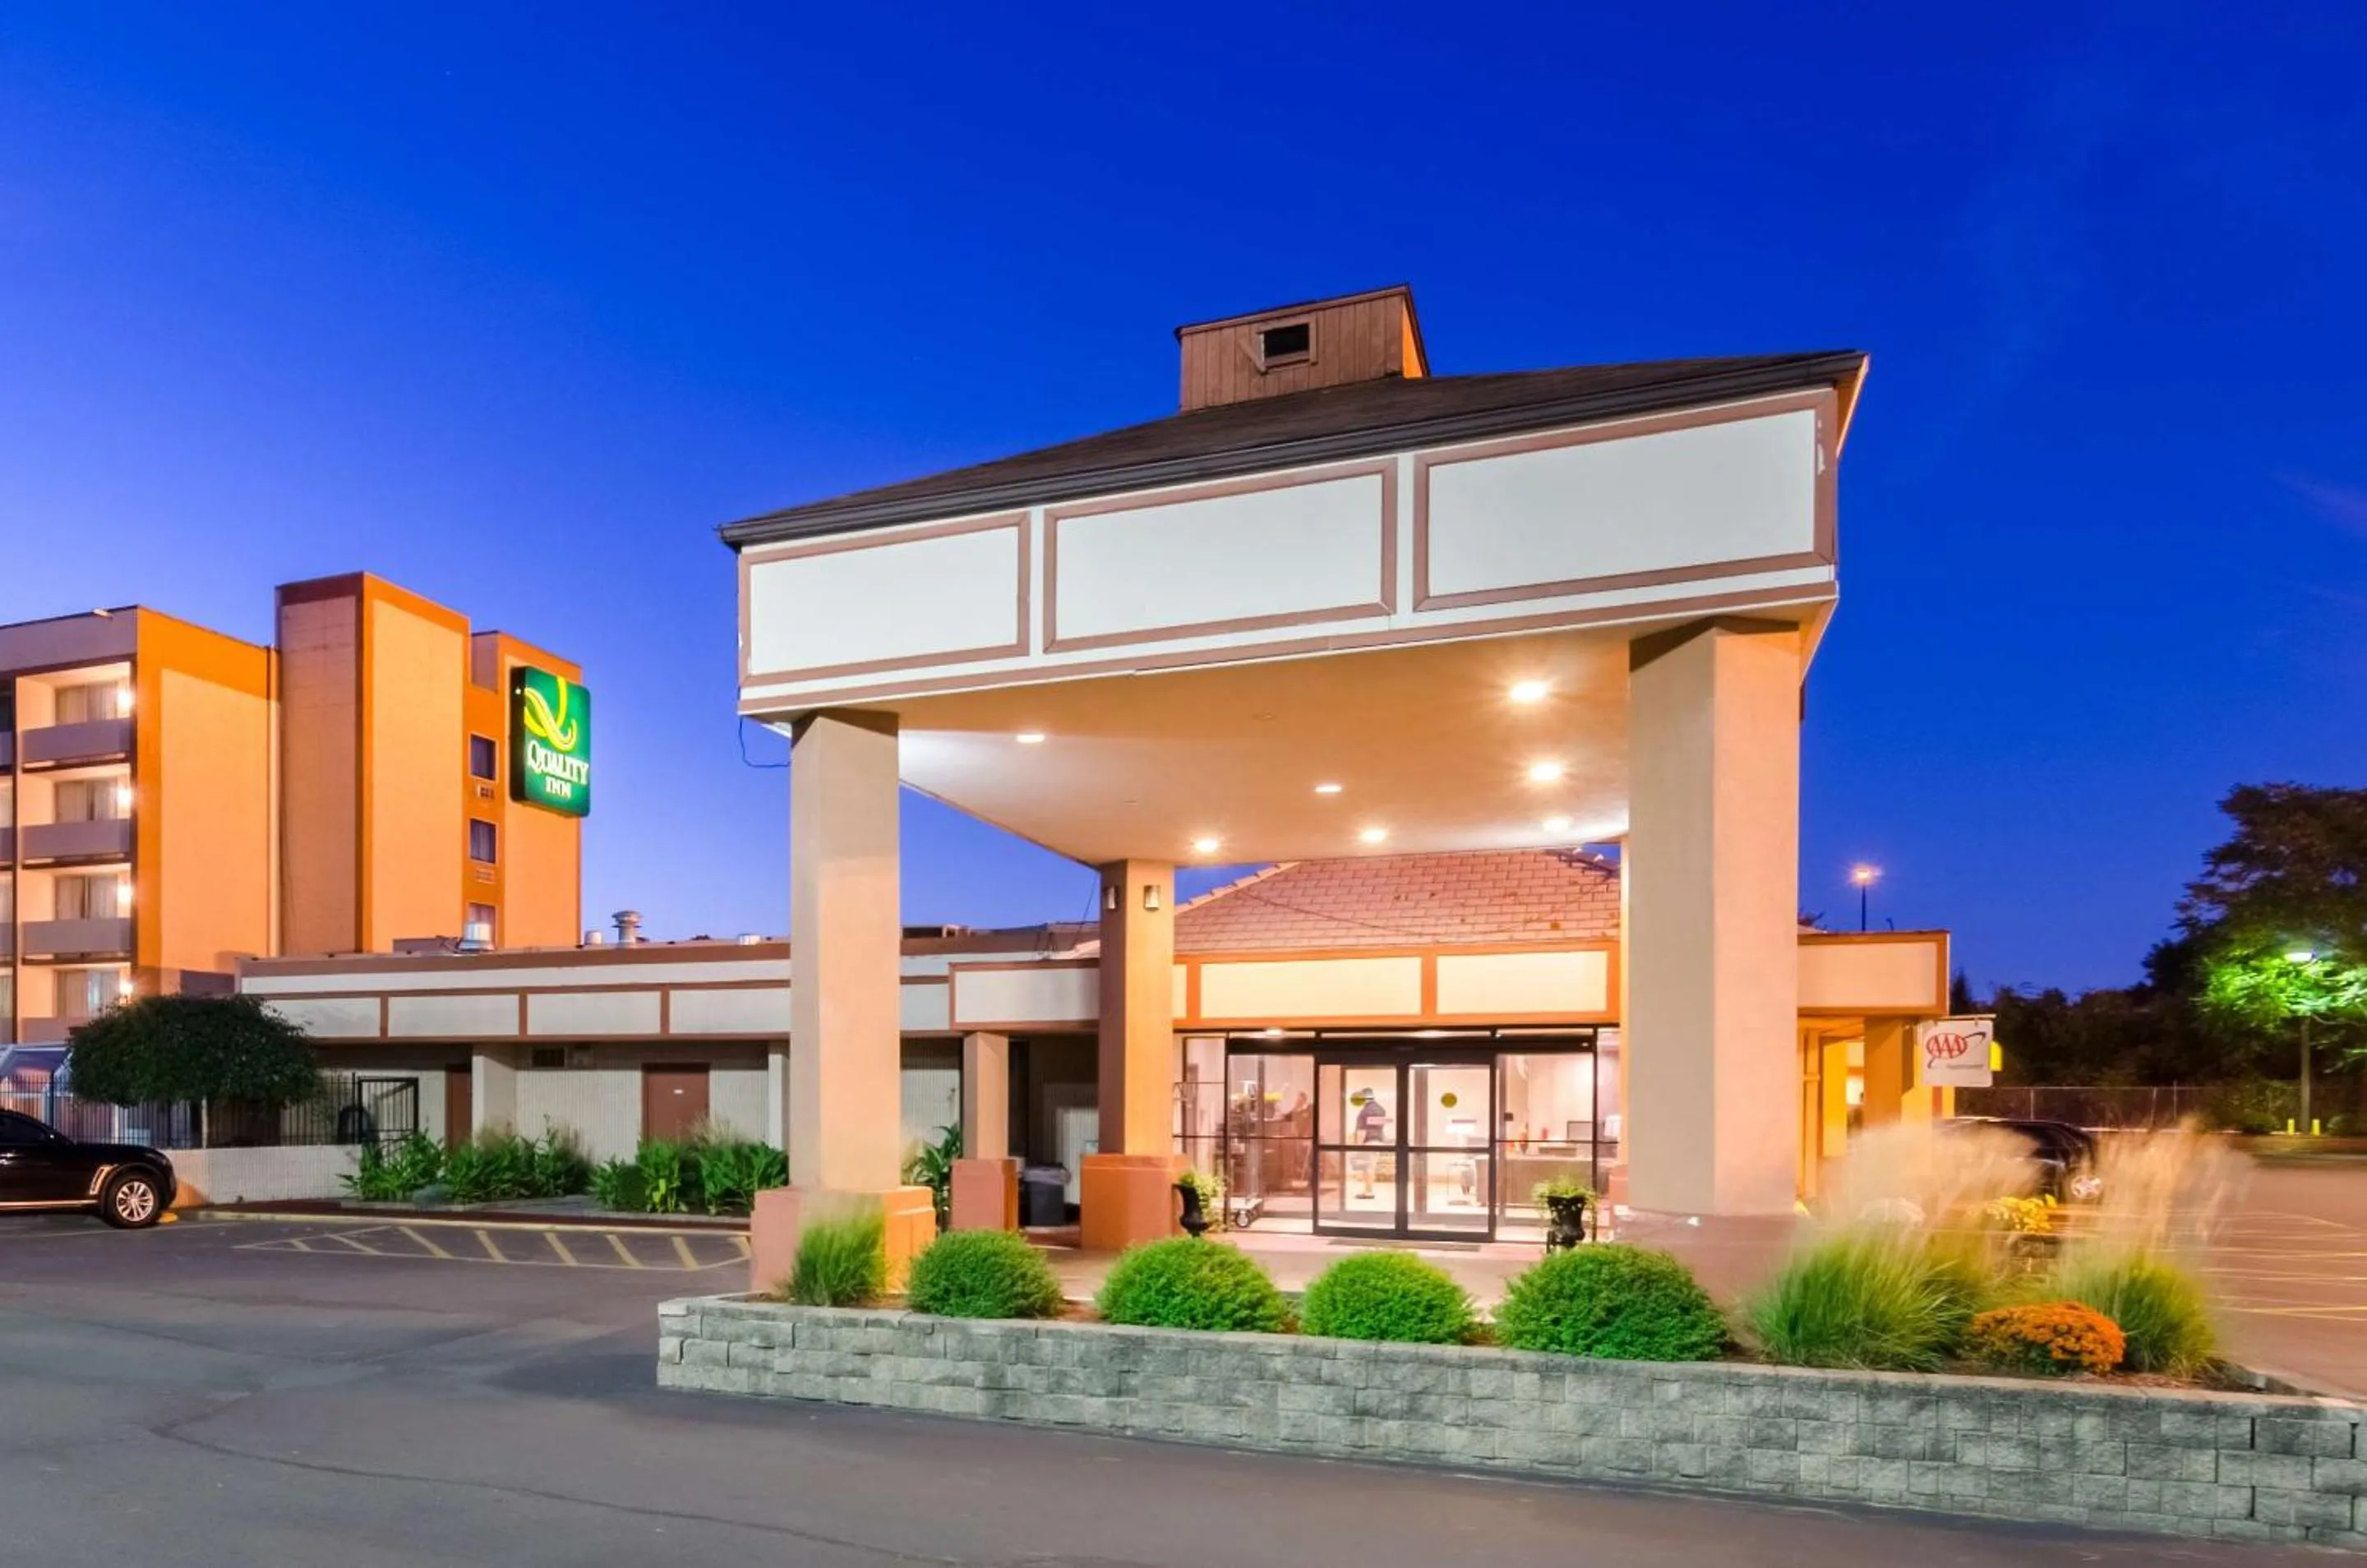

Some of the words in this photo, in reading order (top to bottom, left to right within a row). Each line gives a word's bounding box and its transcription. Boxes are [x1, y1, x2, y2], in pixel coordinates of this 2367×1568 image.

[528, 740, 589, 785] QUALITY
[545, 776, 571, 799] INN
[1928, 1033, 1965, 1058] AAA
